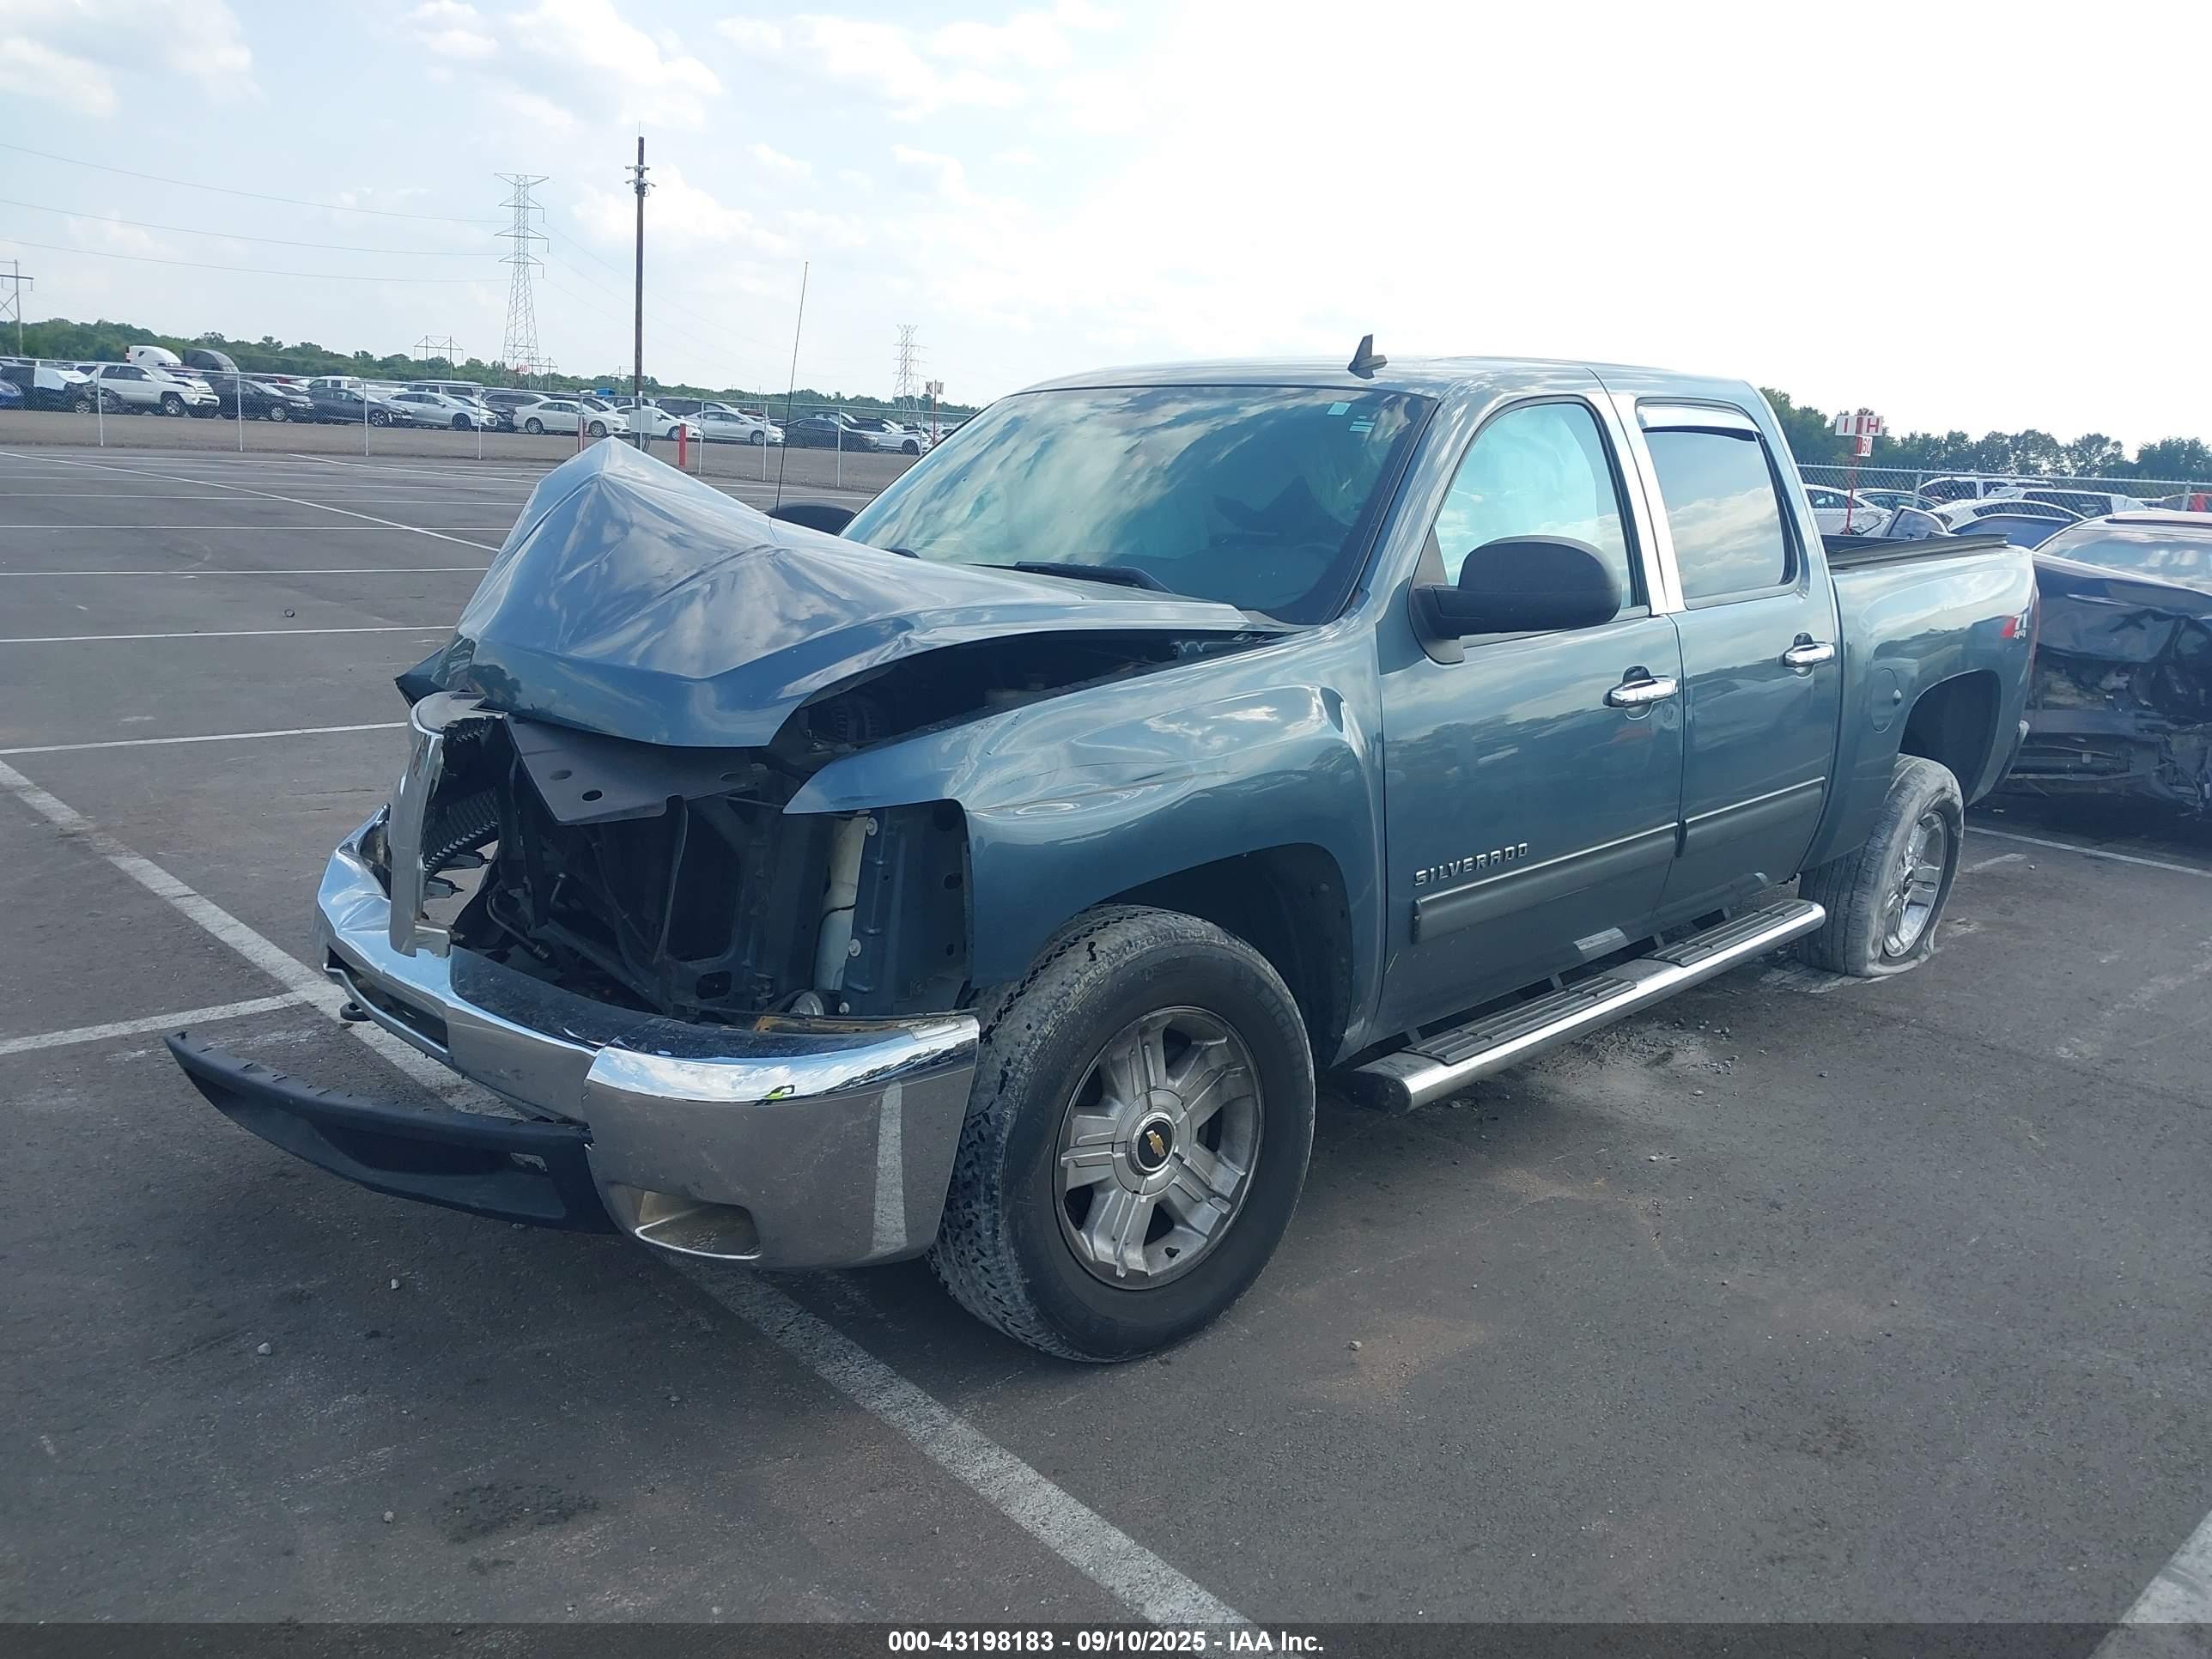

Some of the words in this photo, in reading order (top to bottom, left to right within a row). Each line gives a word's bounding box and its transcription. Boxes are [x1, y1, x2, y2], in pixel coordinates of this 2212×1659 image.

[1866, 417, 1880, 434] H
[1862, 438, 1871, 454] 60
[1412, 842, 1528, 887] SILVERADO
